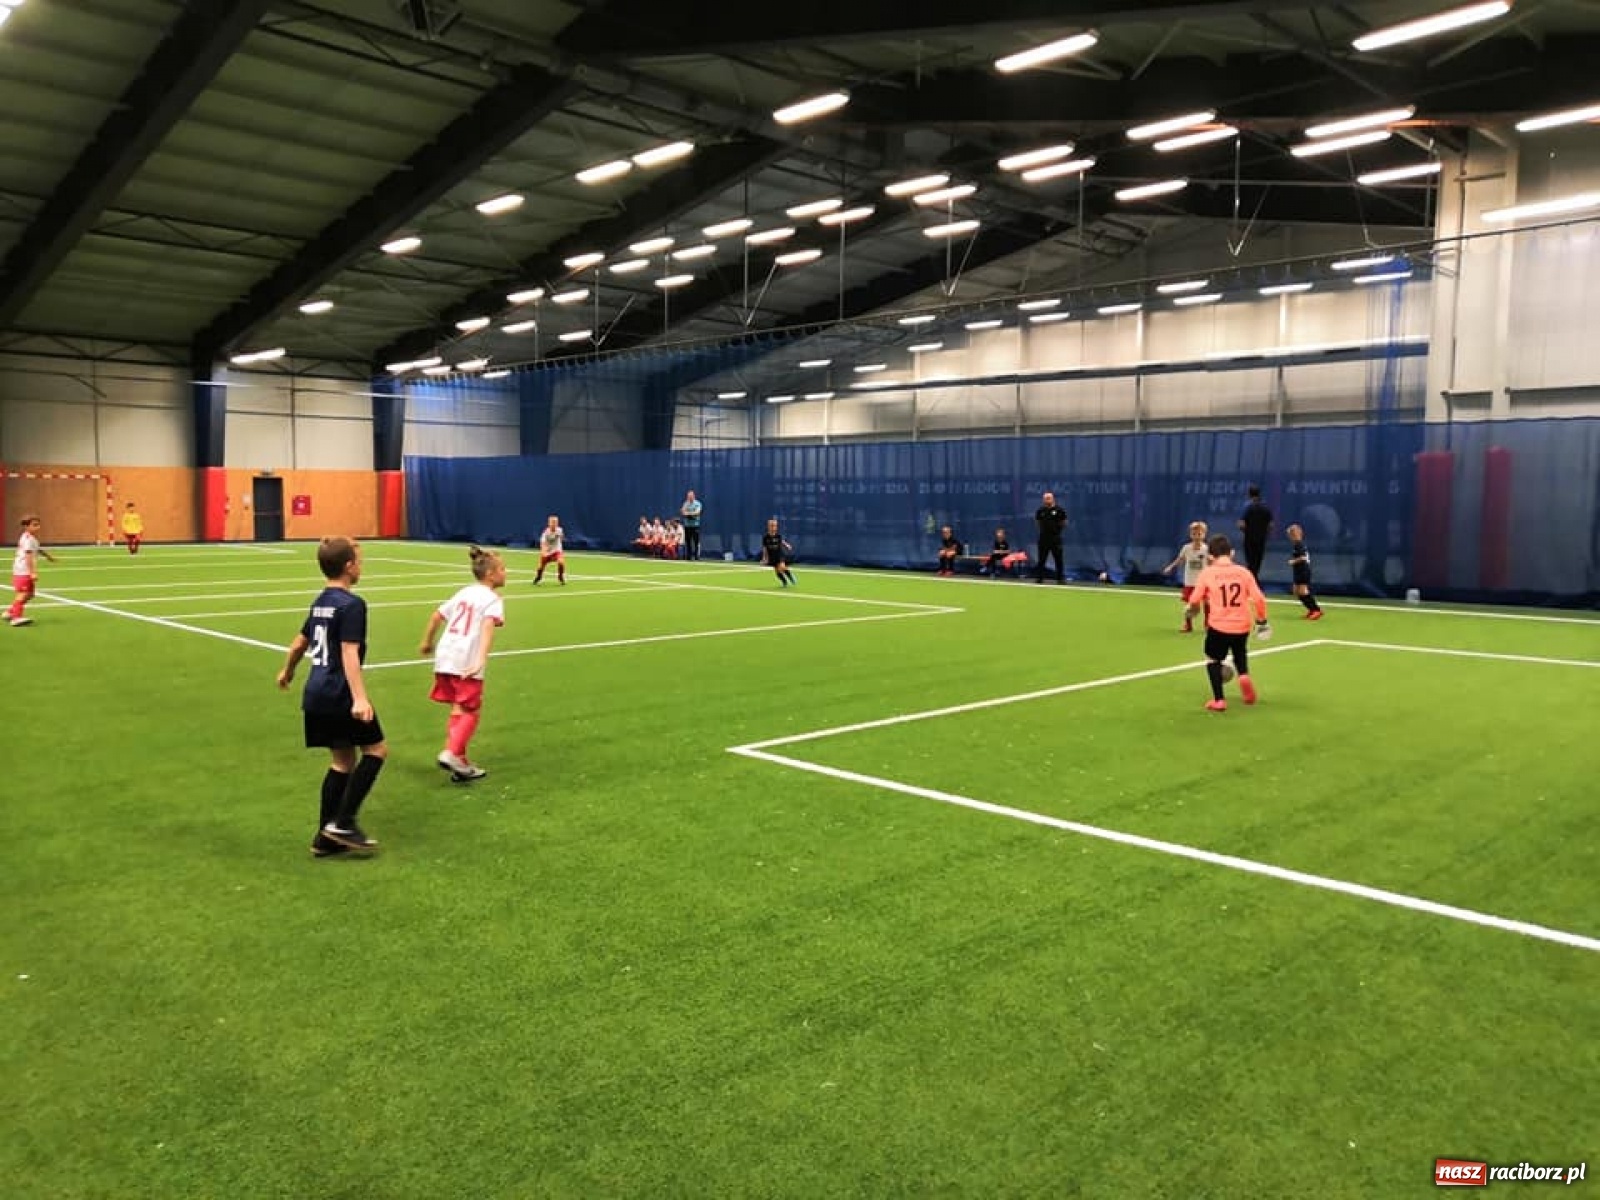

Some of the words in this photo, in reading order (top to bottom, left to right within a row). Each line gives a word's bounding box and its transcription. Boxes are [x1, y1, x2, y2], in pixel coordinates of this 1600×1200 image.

[1219, 582, 1241, 608] 12
[448, 601, 475, 636] 21
[312, 624, 329, 667] 21
